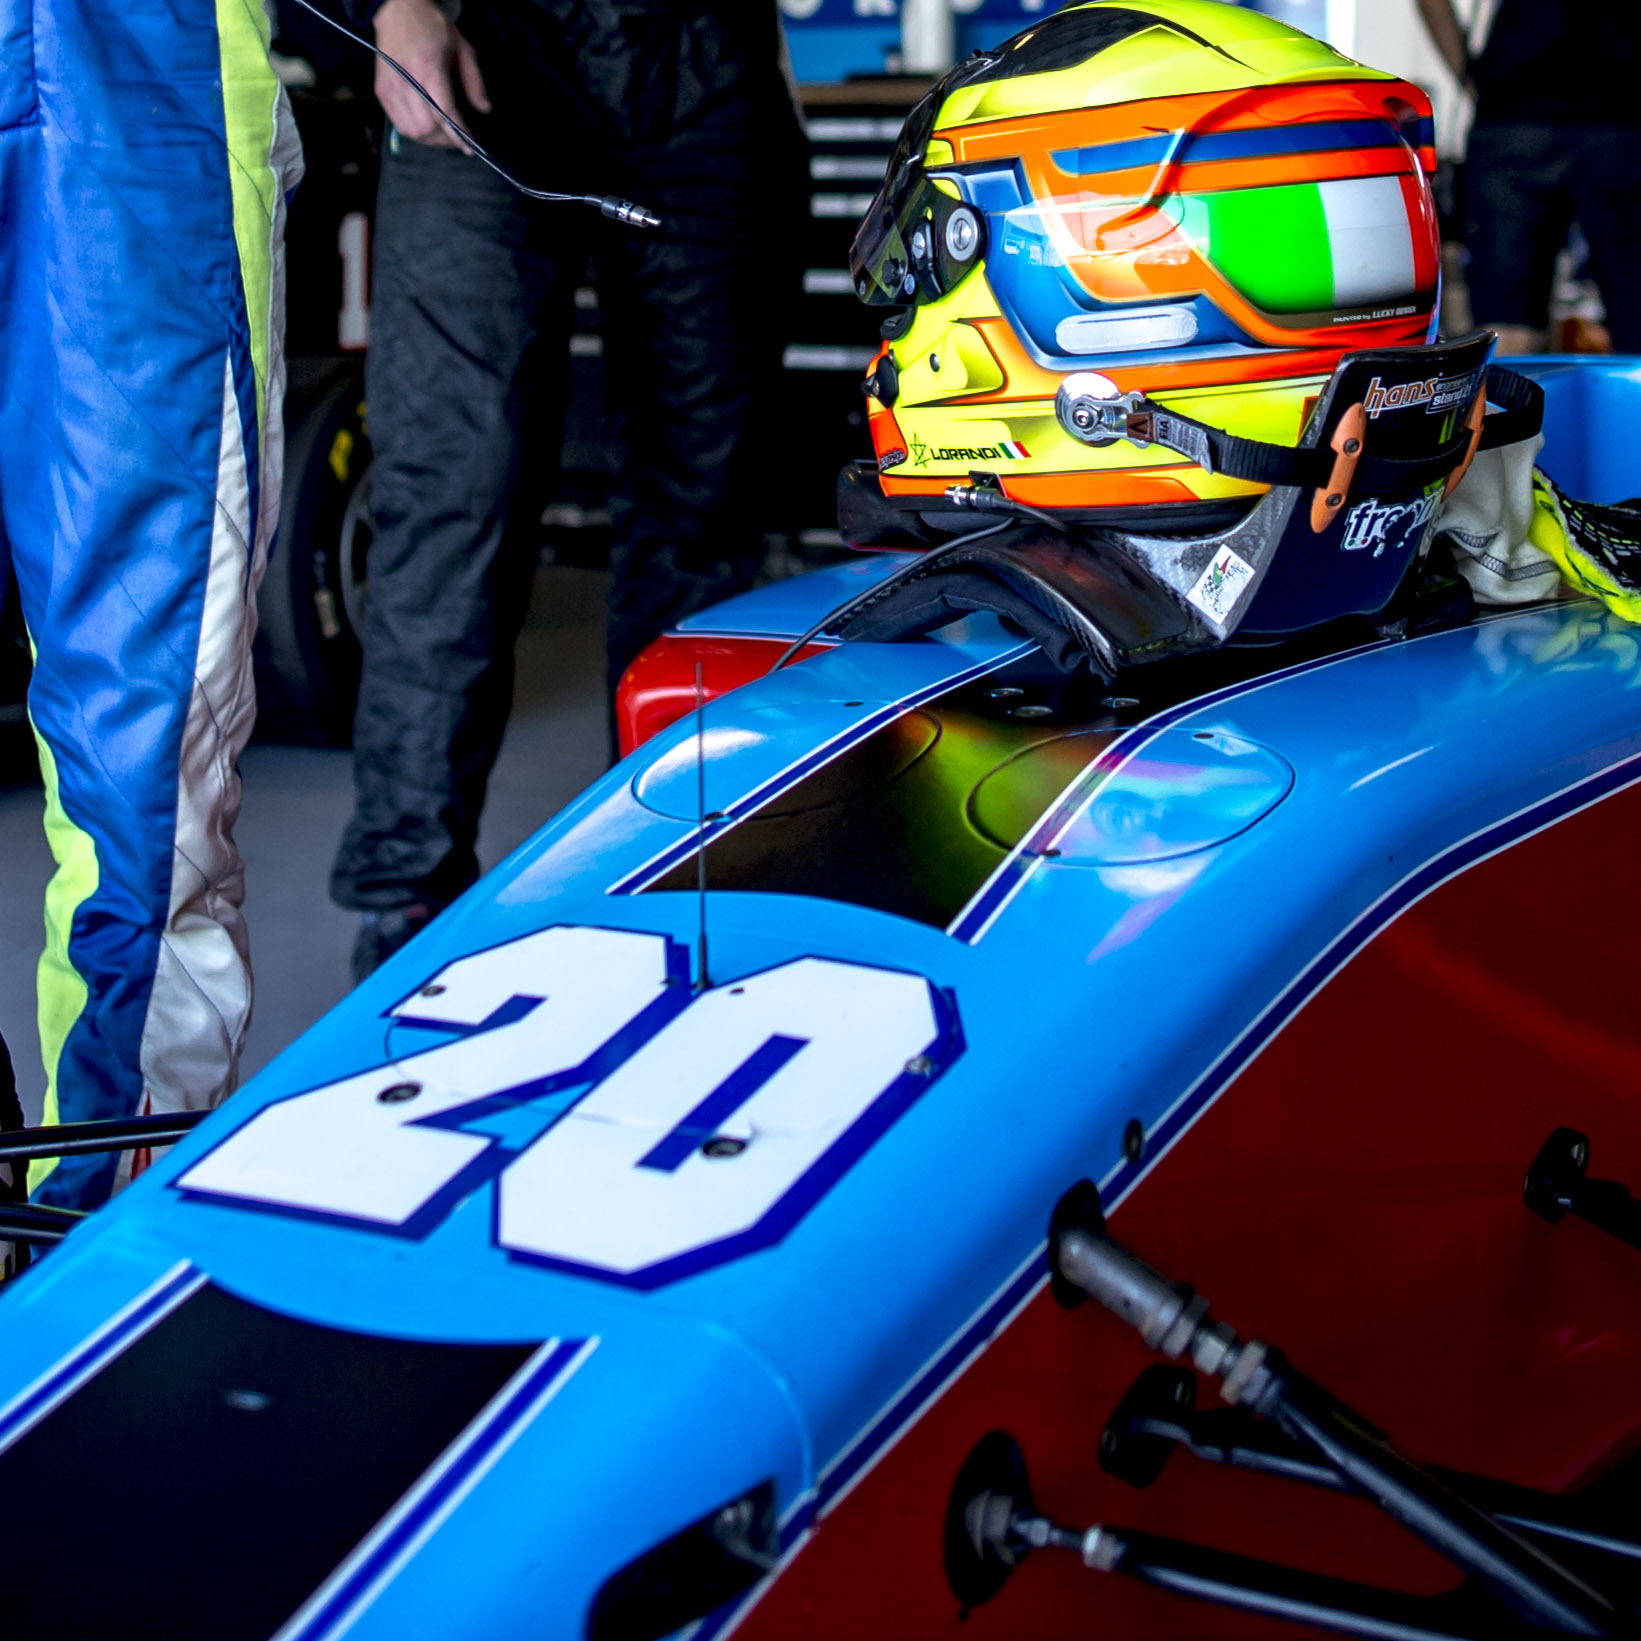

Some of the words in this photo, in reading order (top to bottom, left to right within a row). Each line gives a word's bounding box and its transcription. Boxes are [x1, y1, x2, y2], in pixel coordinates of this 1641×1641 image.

[1363, 377, 1438, 419] hans
[930, 447, 1002, 461] LORANDI
[166, 924, 964, 1290] 20
